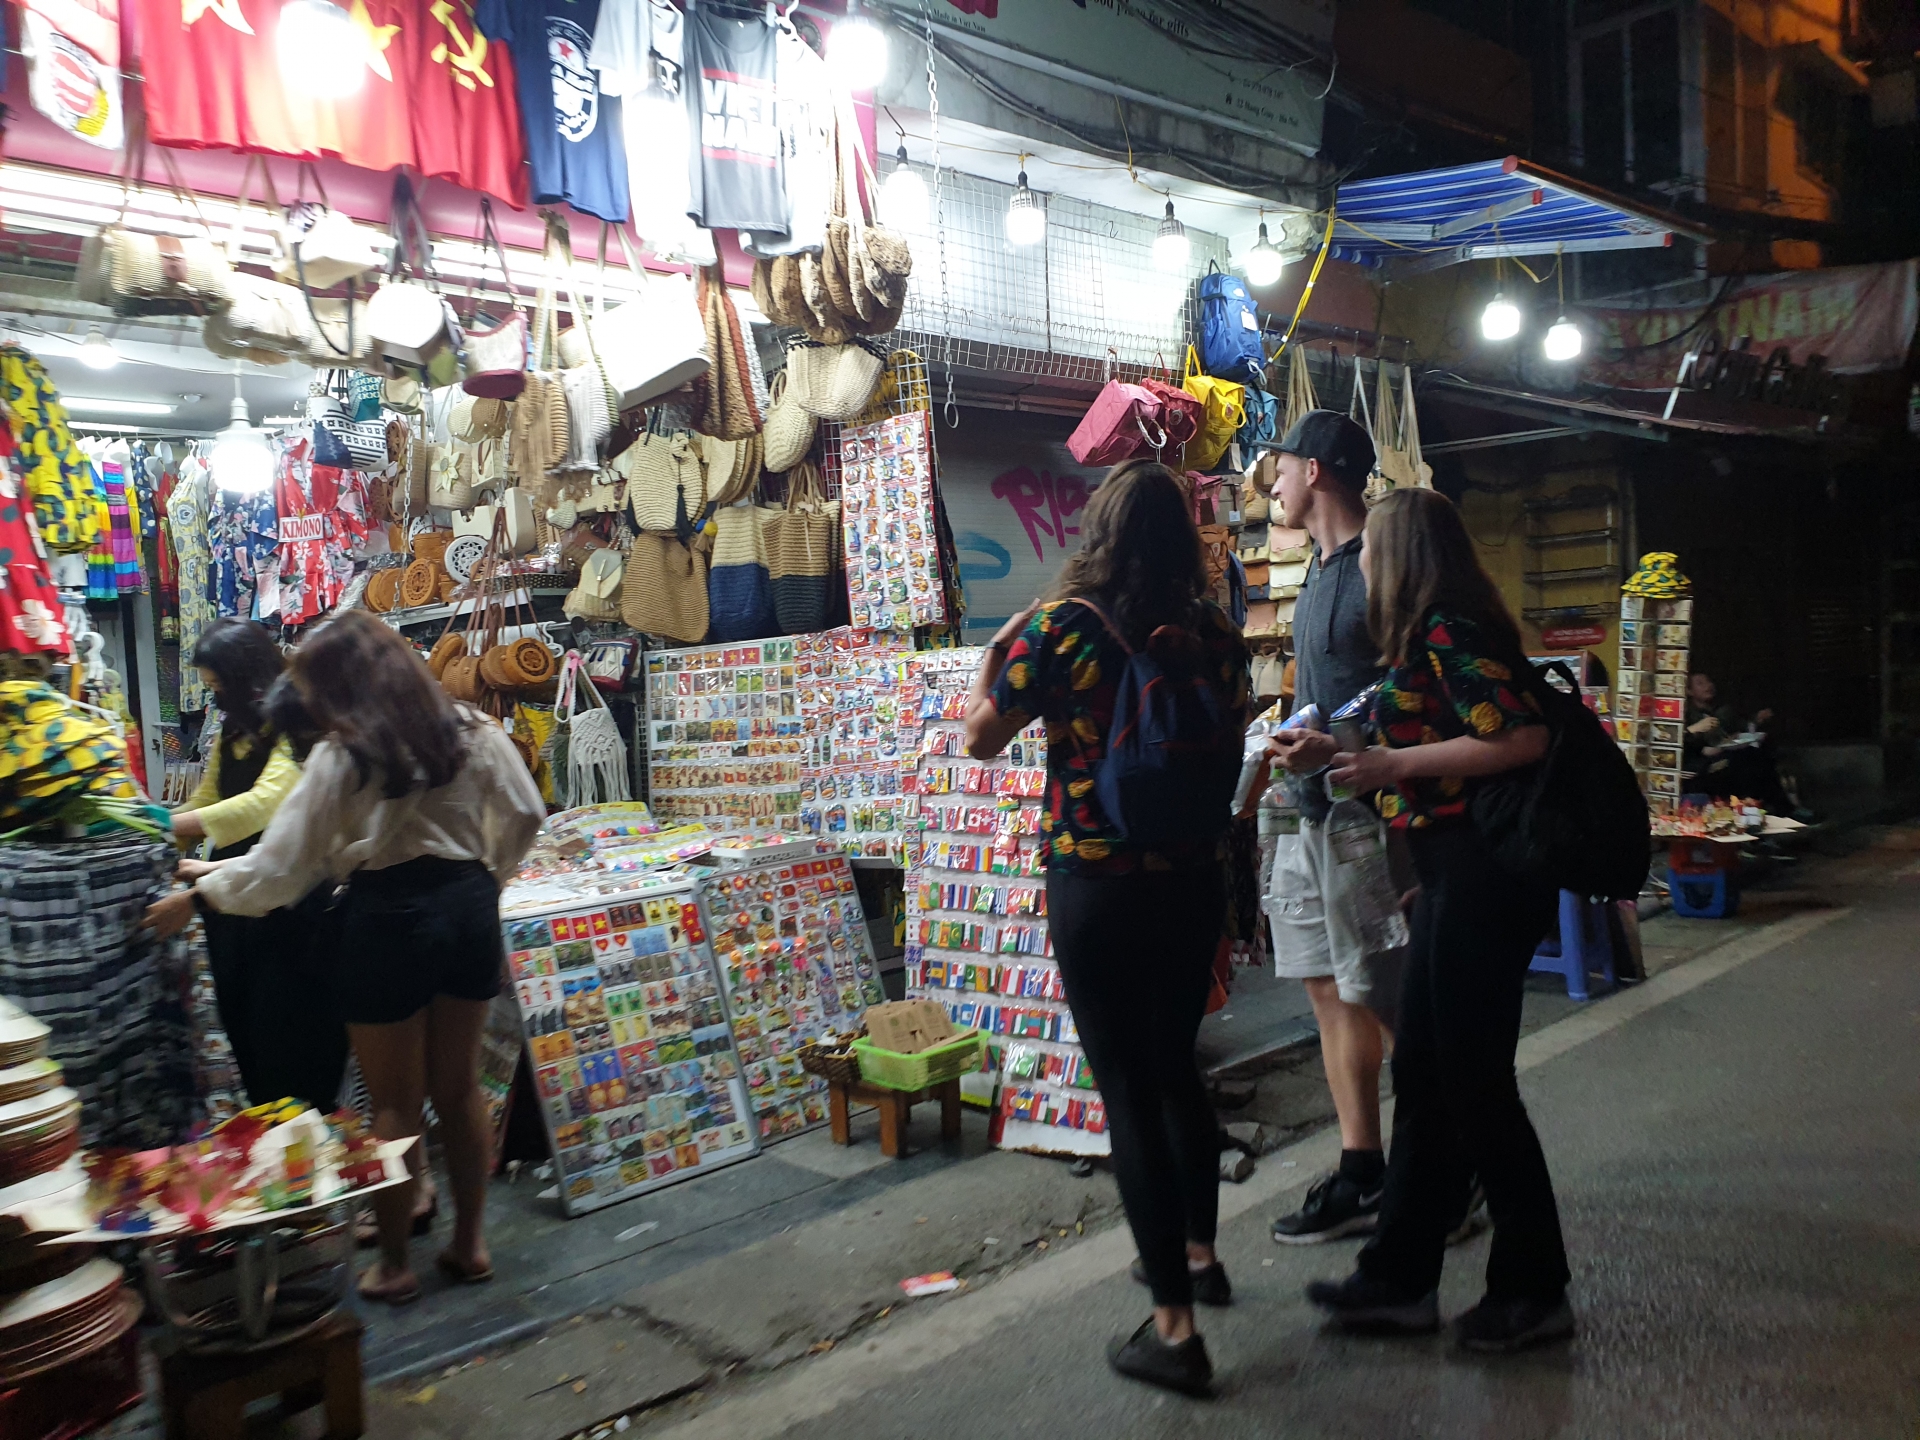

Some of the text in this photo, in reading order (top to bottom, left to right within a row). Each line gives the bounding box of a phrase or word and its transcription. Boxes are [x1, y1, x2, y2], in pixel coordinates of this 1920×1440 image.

[933, 8, 986, 33] Made in Viet Nam
[1166, 18, 1189, 37] gifts
[281, 517, 321, 539] KIMONO
